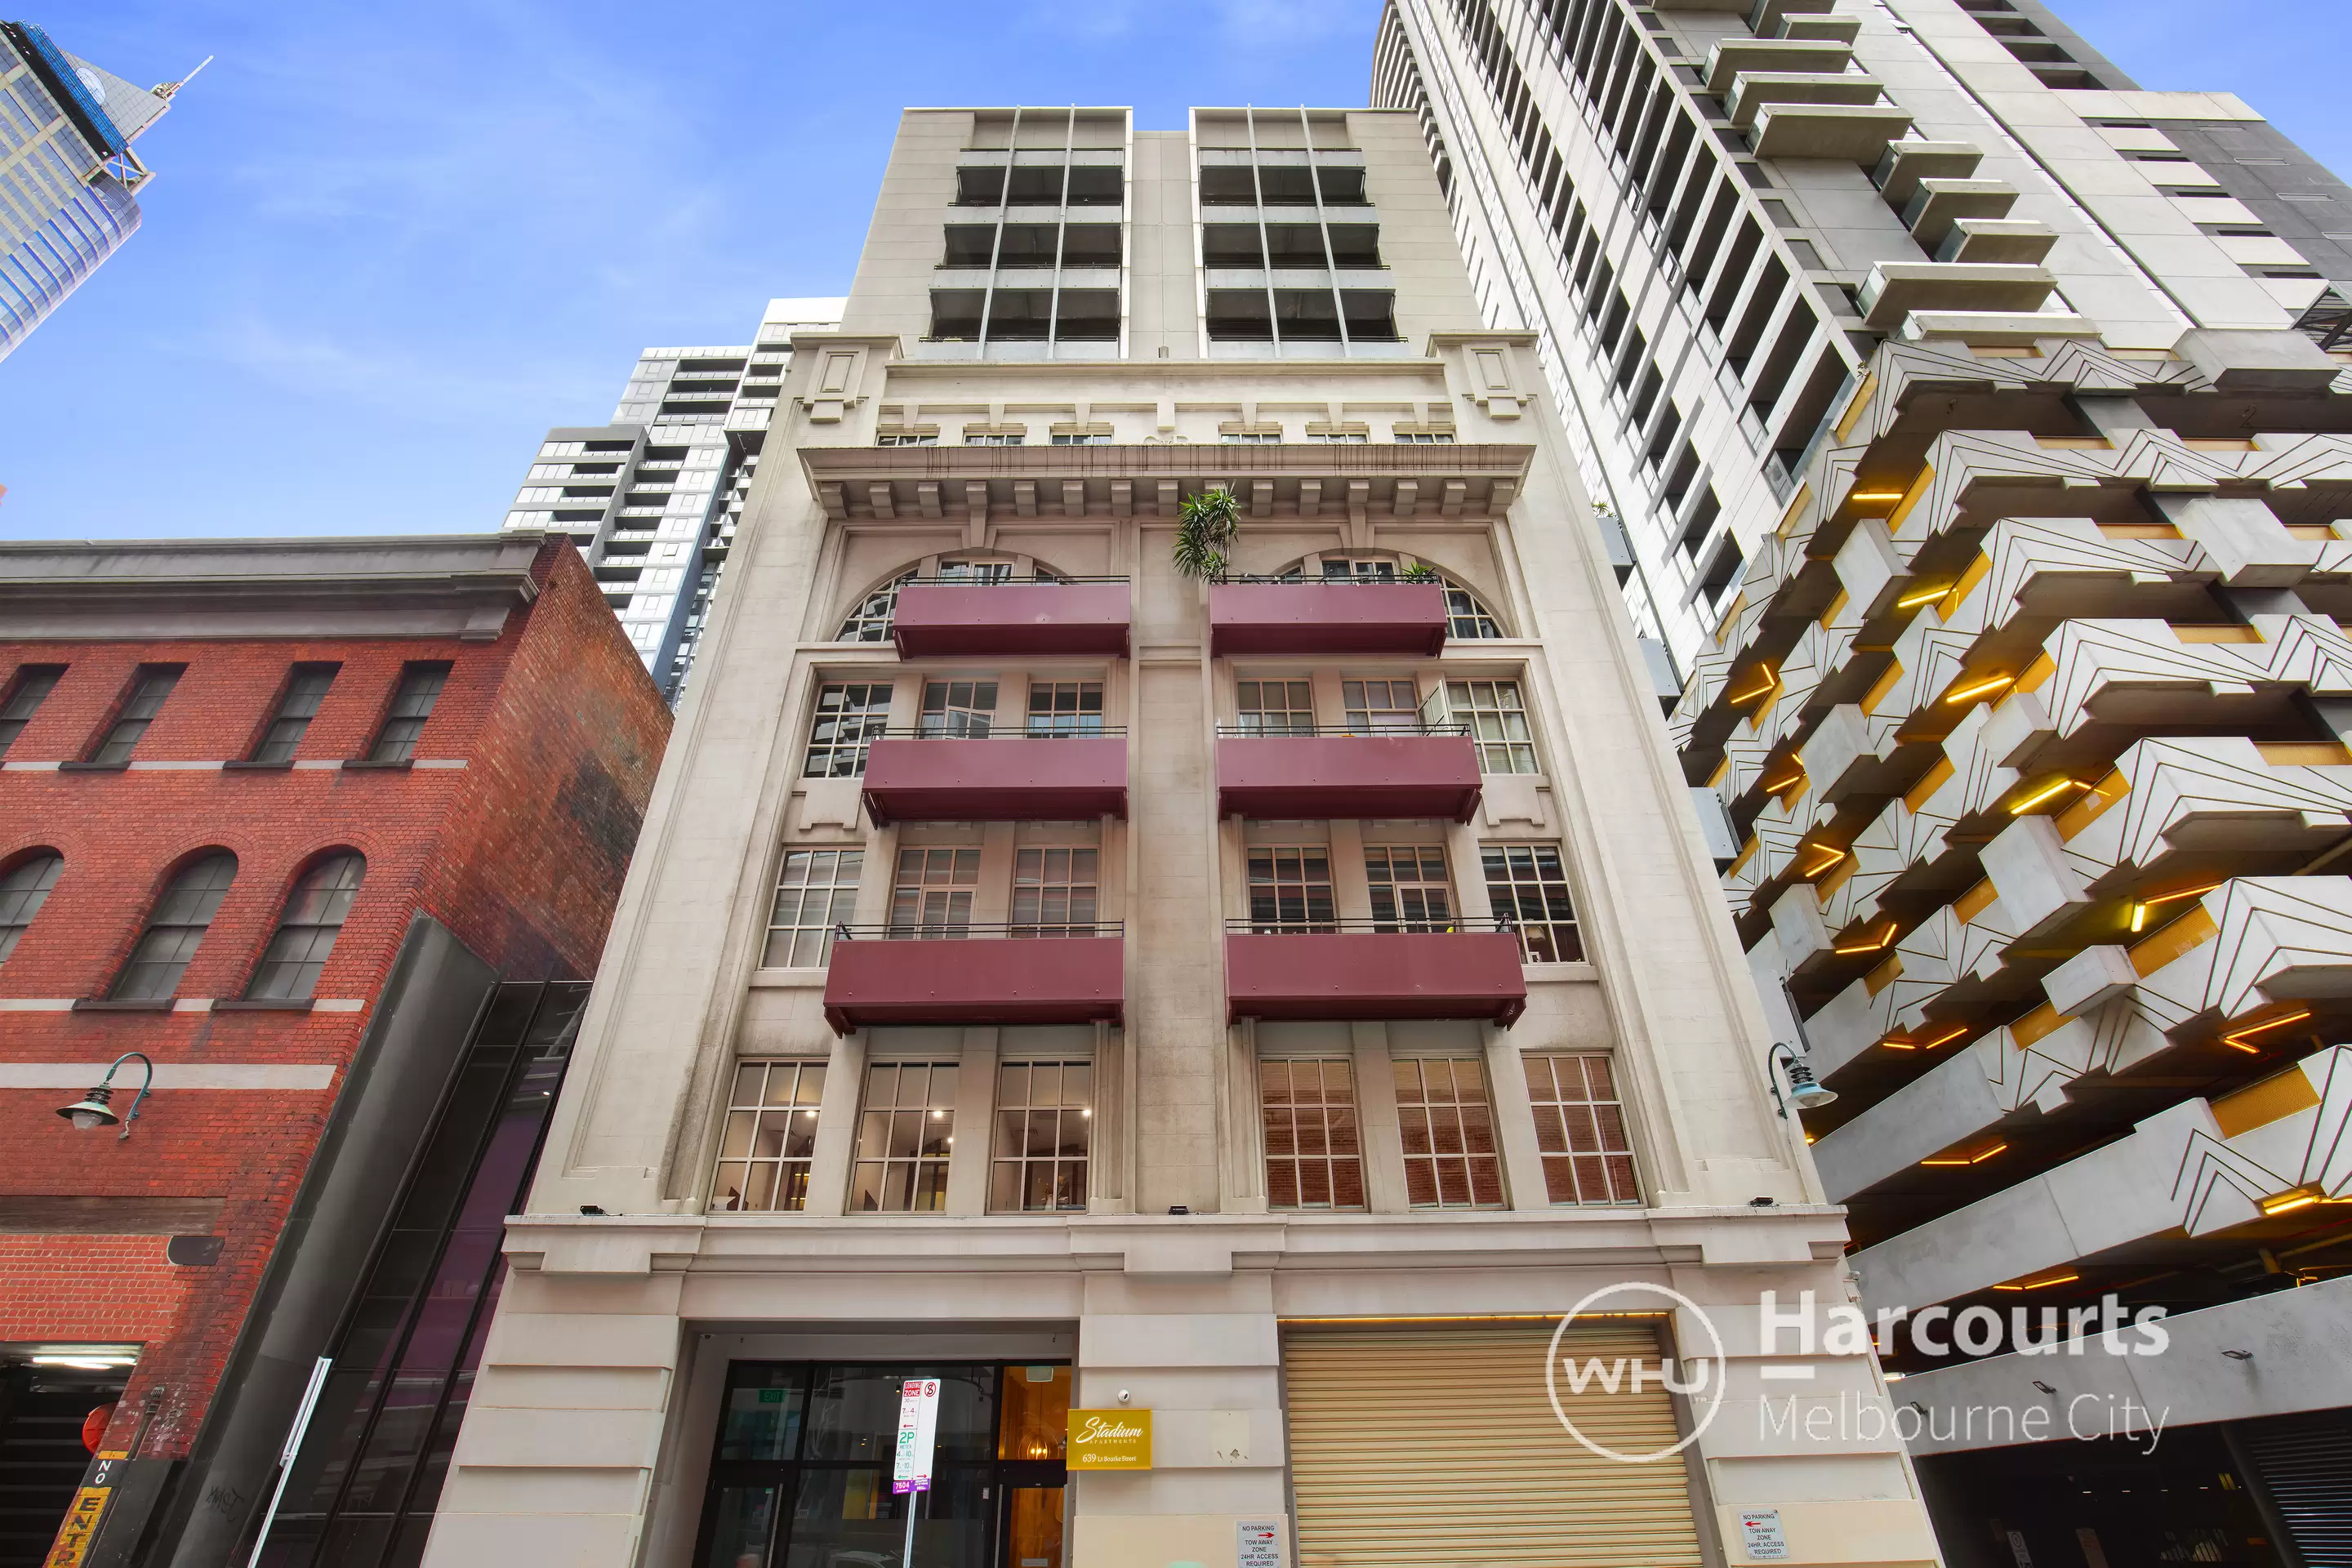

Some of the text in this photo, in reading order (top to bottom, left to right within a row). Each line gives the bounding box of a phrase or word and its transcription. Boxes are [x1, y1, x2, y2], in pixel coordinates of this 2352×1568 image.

[764, 1391, 782, 1401] EXIT
[1076, 1416, 1143, 1444] Stadium
[899, 1432, 915, 1444] 2P
[1082, 1454, 1096, 1463] 639
[95, 1460, 112, 1484] NO
[895, 1481, 910, 1490] 7504
